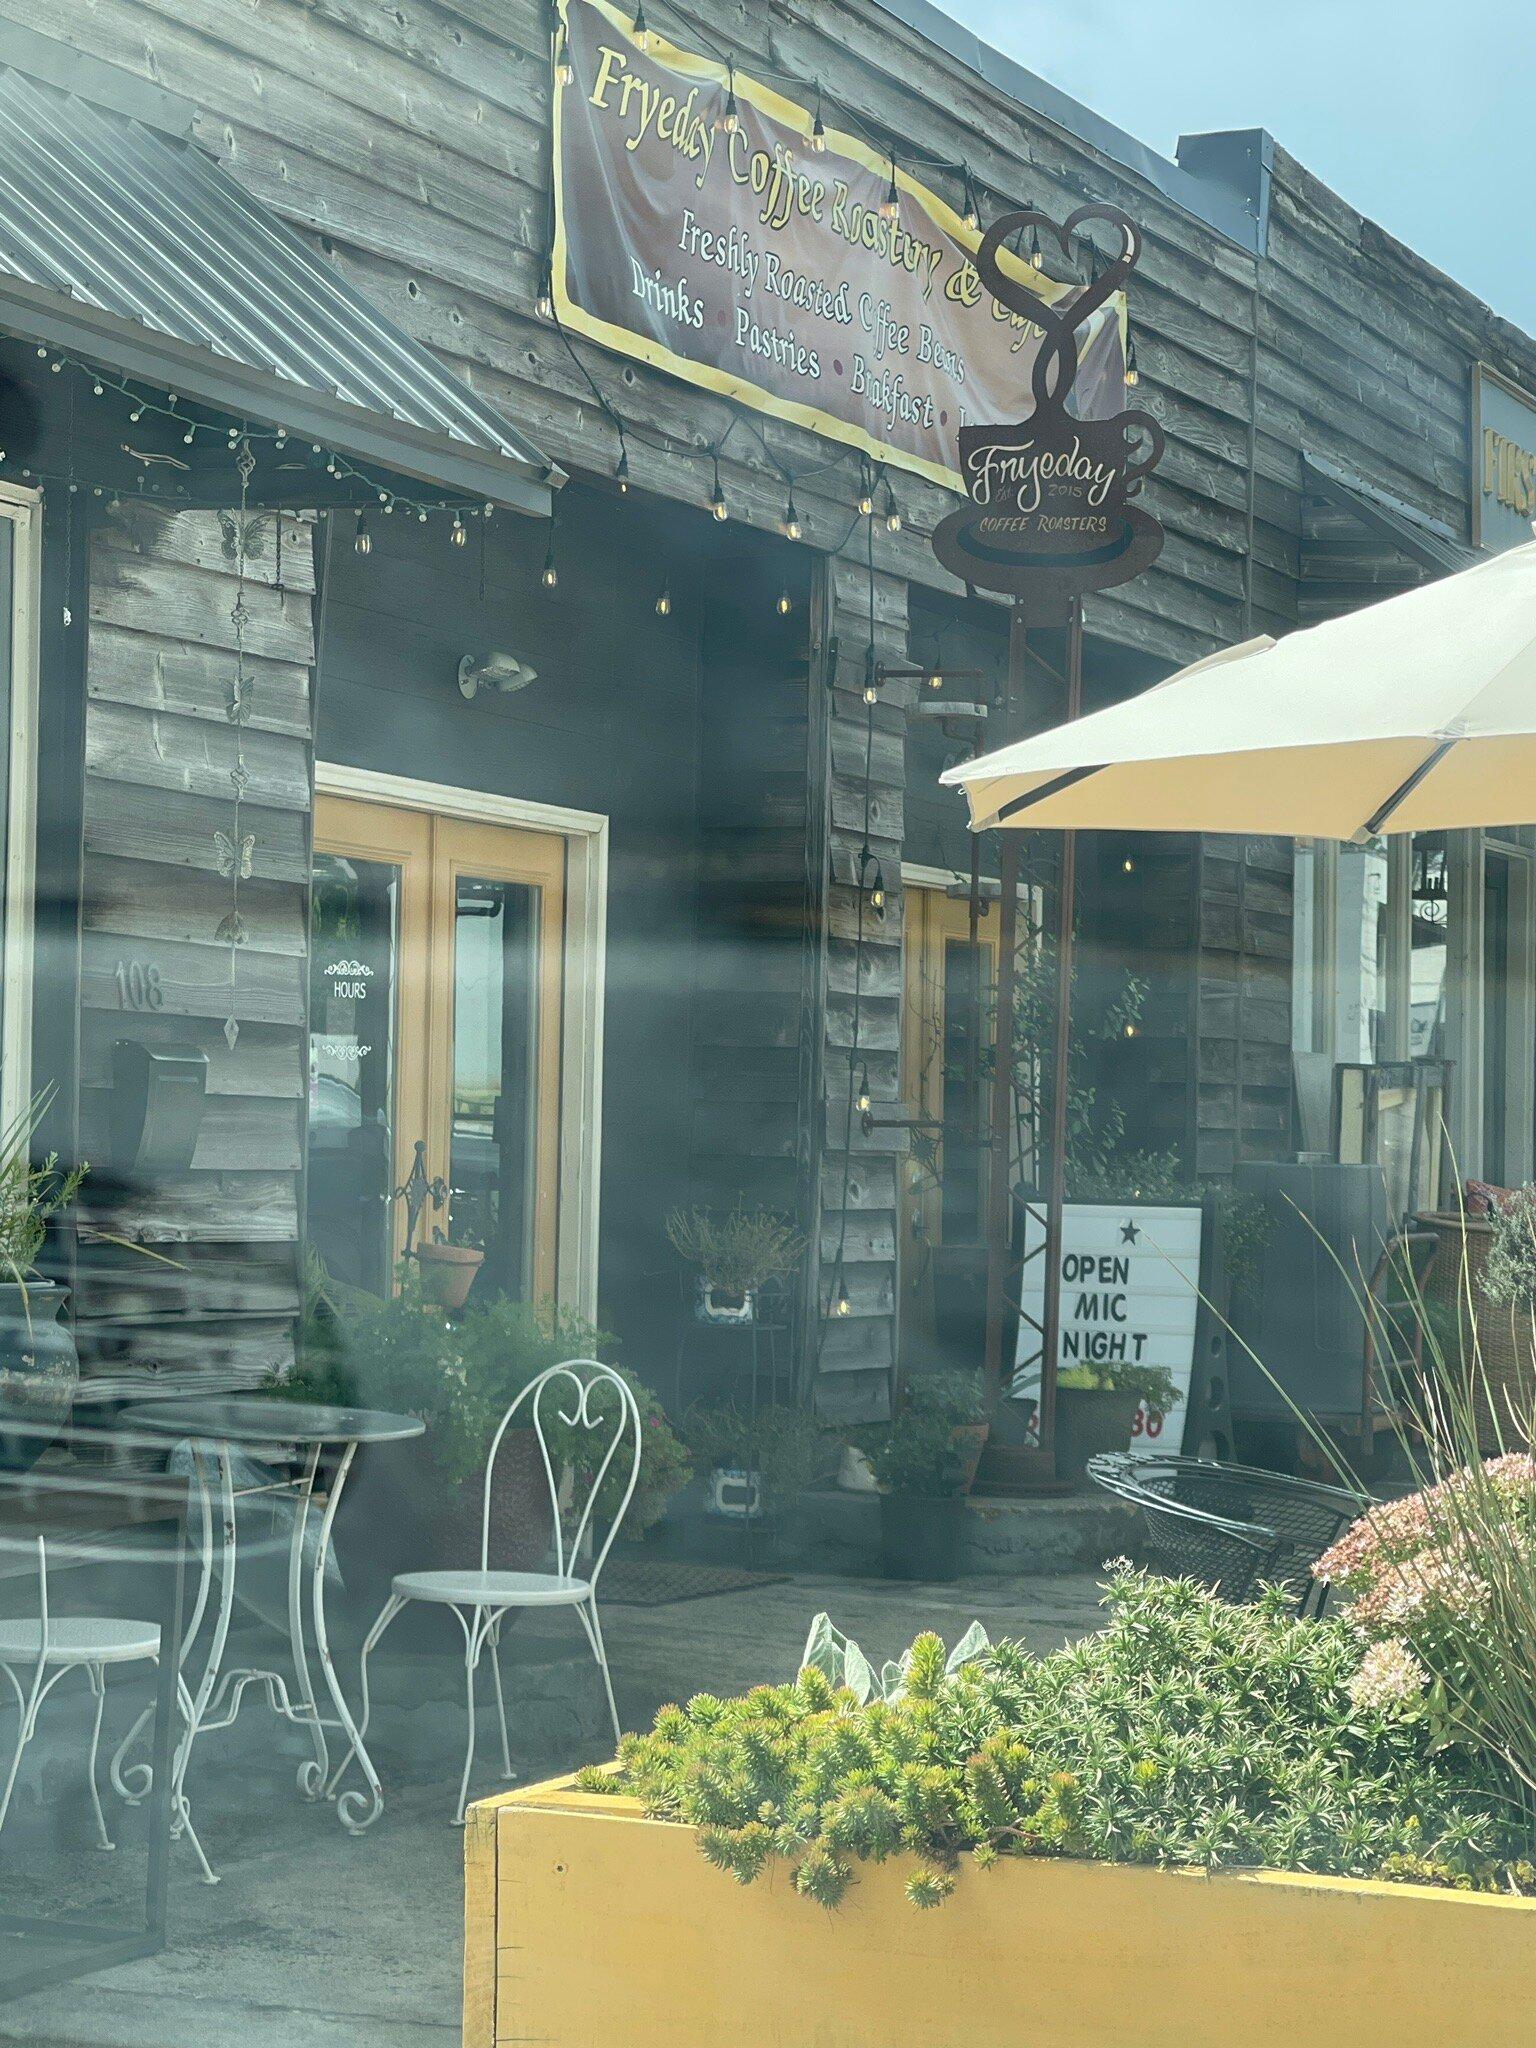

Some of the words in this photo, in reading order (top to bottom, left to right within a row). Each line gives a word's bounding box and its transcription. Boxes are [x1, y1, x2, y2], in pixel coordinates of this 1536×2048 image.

[588, 46, 716, 189] Fryeday
[727, 126, 825, 230] Coffee
[945, 259, 982, 308] &
[678, 207, 759, 298] Freshly
[765, 251, 852, 324] Roasted
[859, 292, 910, 361] Cffee
[630, 255, 704, 328] Drinks
[735, 305, 821, 379] Pastries
[850, 353, 933, 431] Brakfast
[968, 435, 1116, 512] Fryeday
[1049, 484, 1084, 498] 2015
[979, 516, 1030, 533] COFFEE
[1037, 514, 1107, 533] ROASTERS
[115, 961, 163, 1011] 108
[334, 981, 366, 999] HOURS
[1062, 1254, 1129, 1285] OPEN
[1074, 1293, 1127, 1322] MIC
[1062, 1331, 1147, 1361] NIGHT
